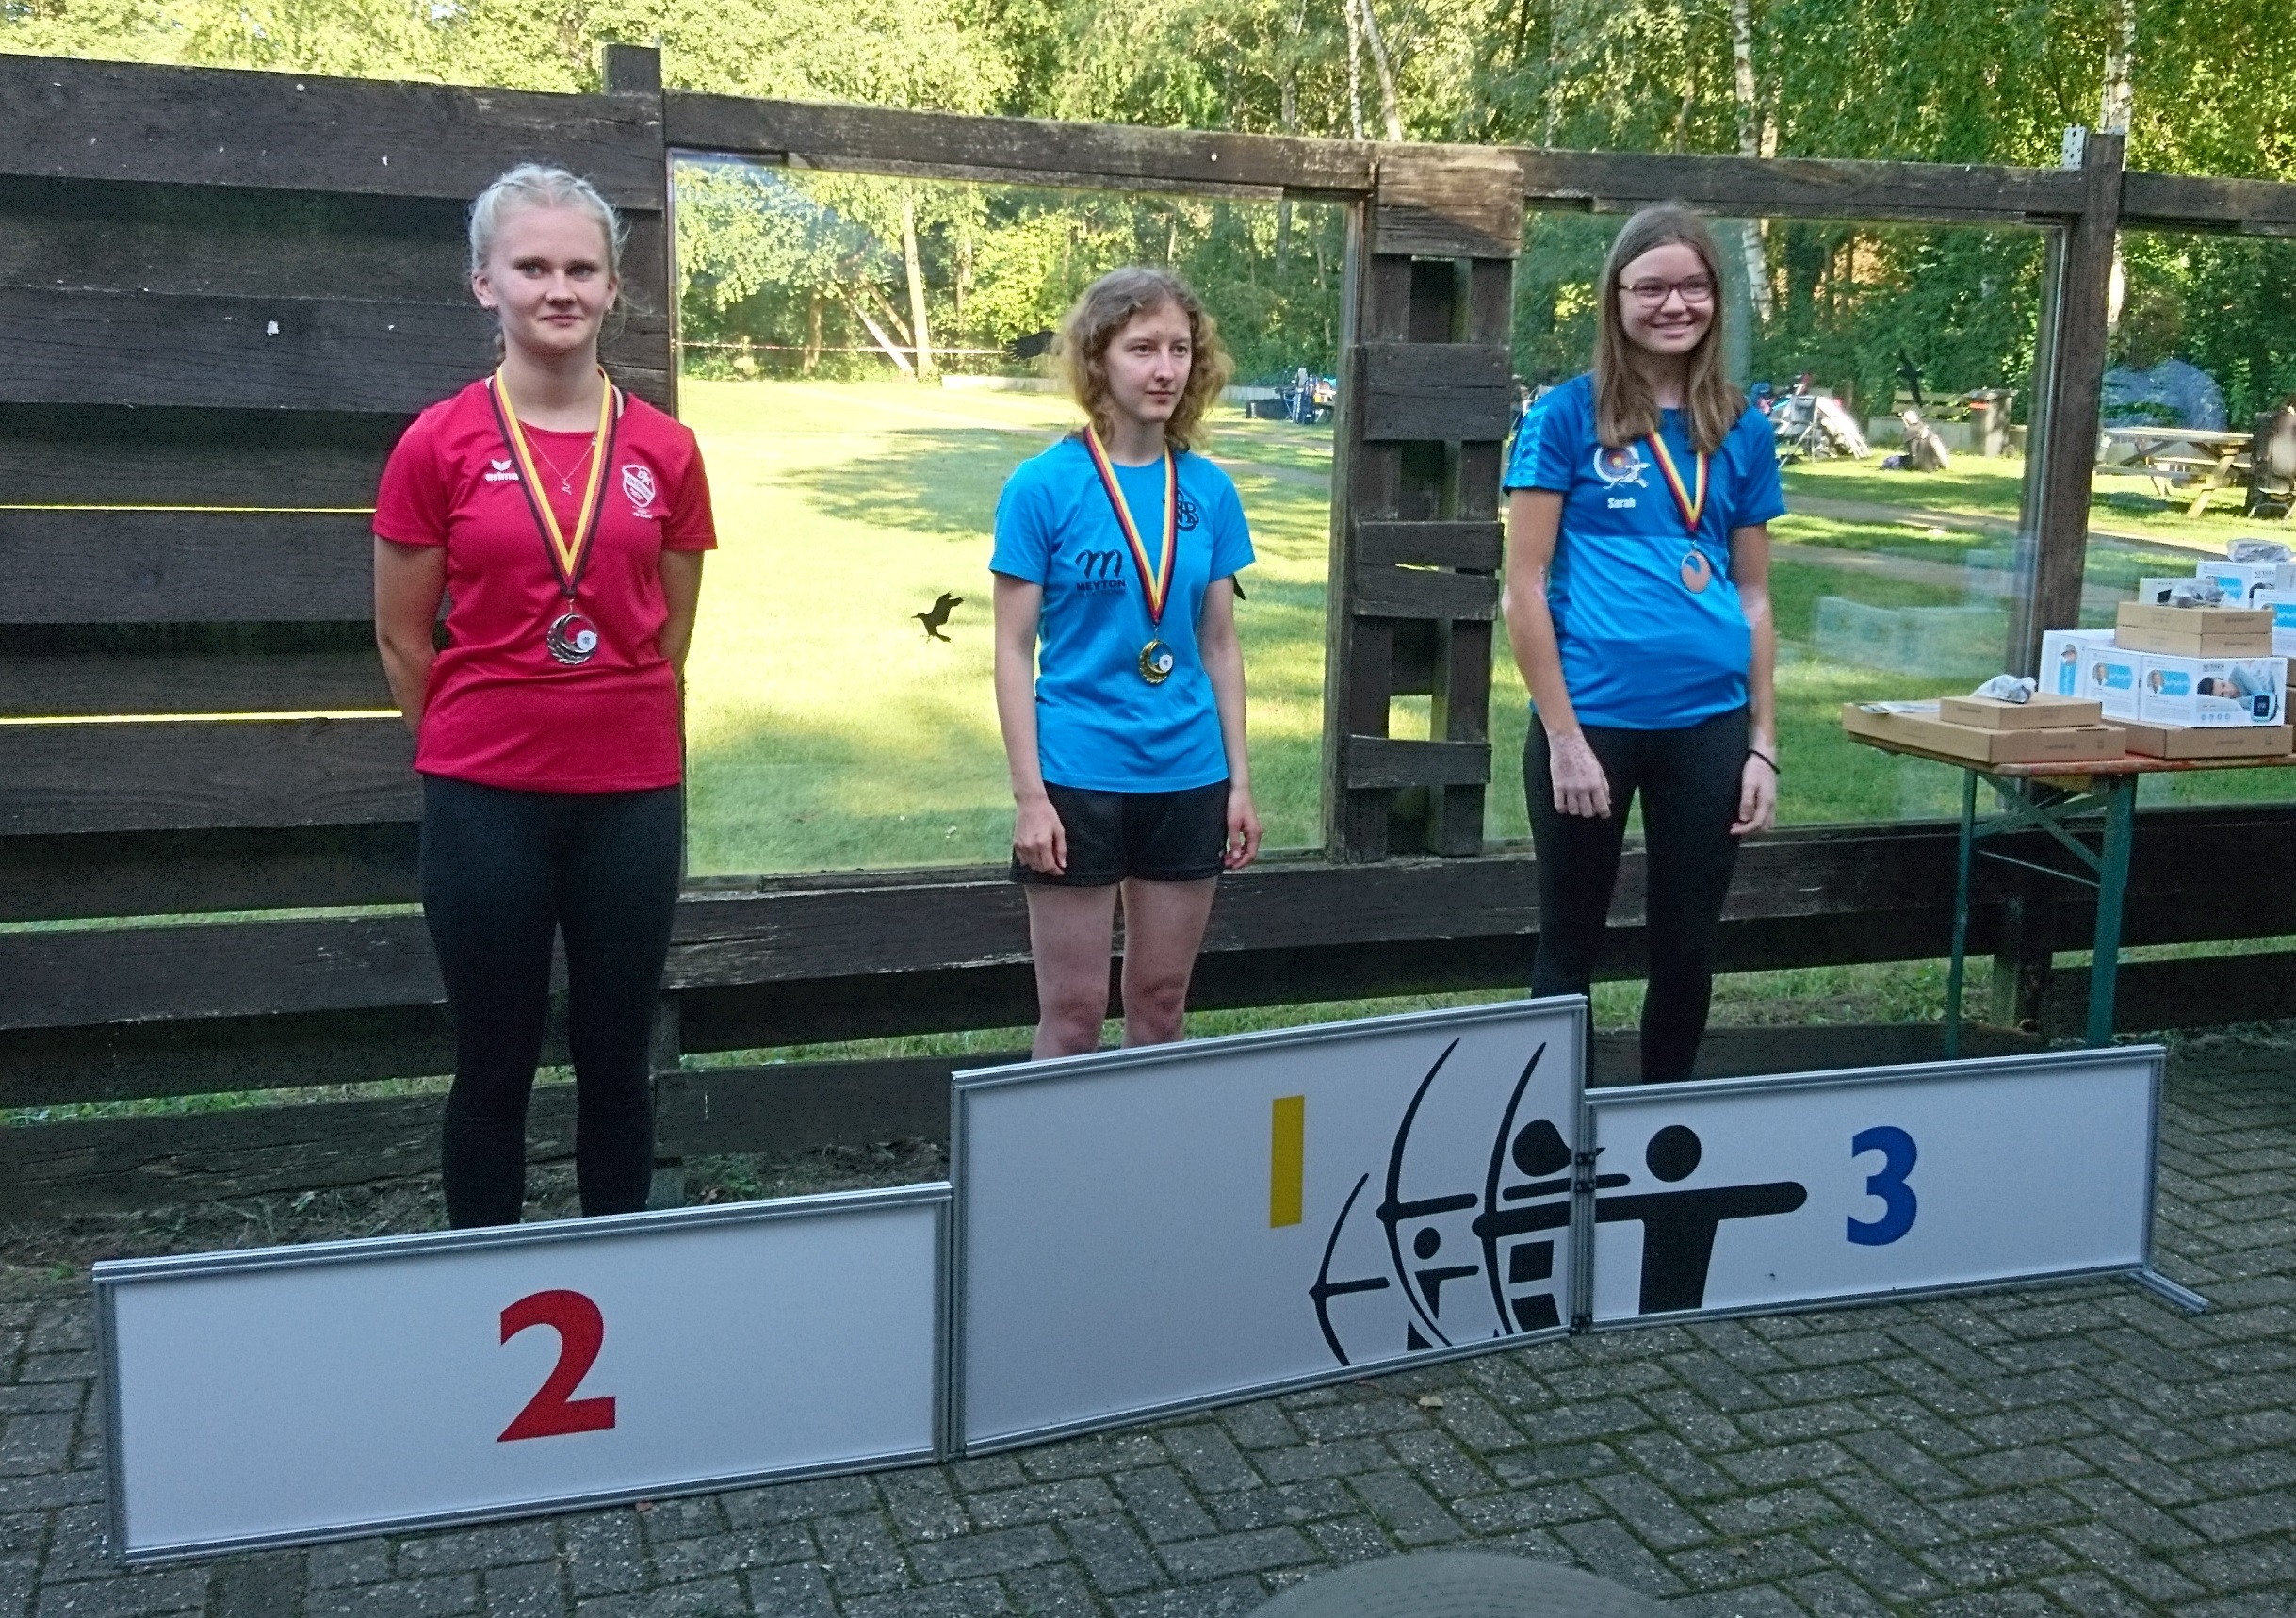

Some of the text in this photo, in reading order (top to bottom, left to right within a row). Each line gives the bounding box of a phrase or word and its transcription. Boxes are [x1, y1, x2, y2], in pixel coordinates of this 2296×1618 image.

[485, 471, 519, 482] erima
[1607, 497, 1636, 509] Sarah
[1076, 580, 1126, 591] MEYTON
[1845, 1125, 1918, 1247] 3
[496, 1289, 616, 1443] 2
